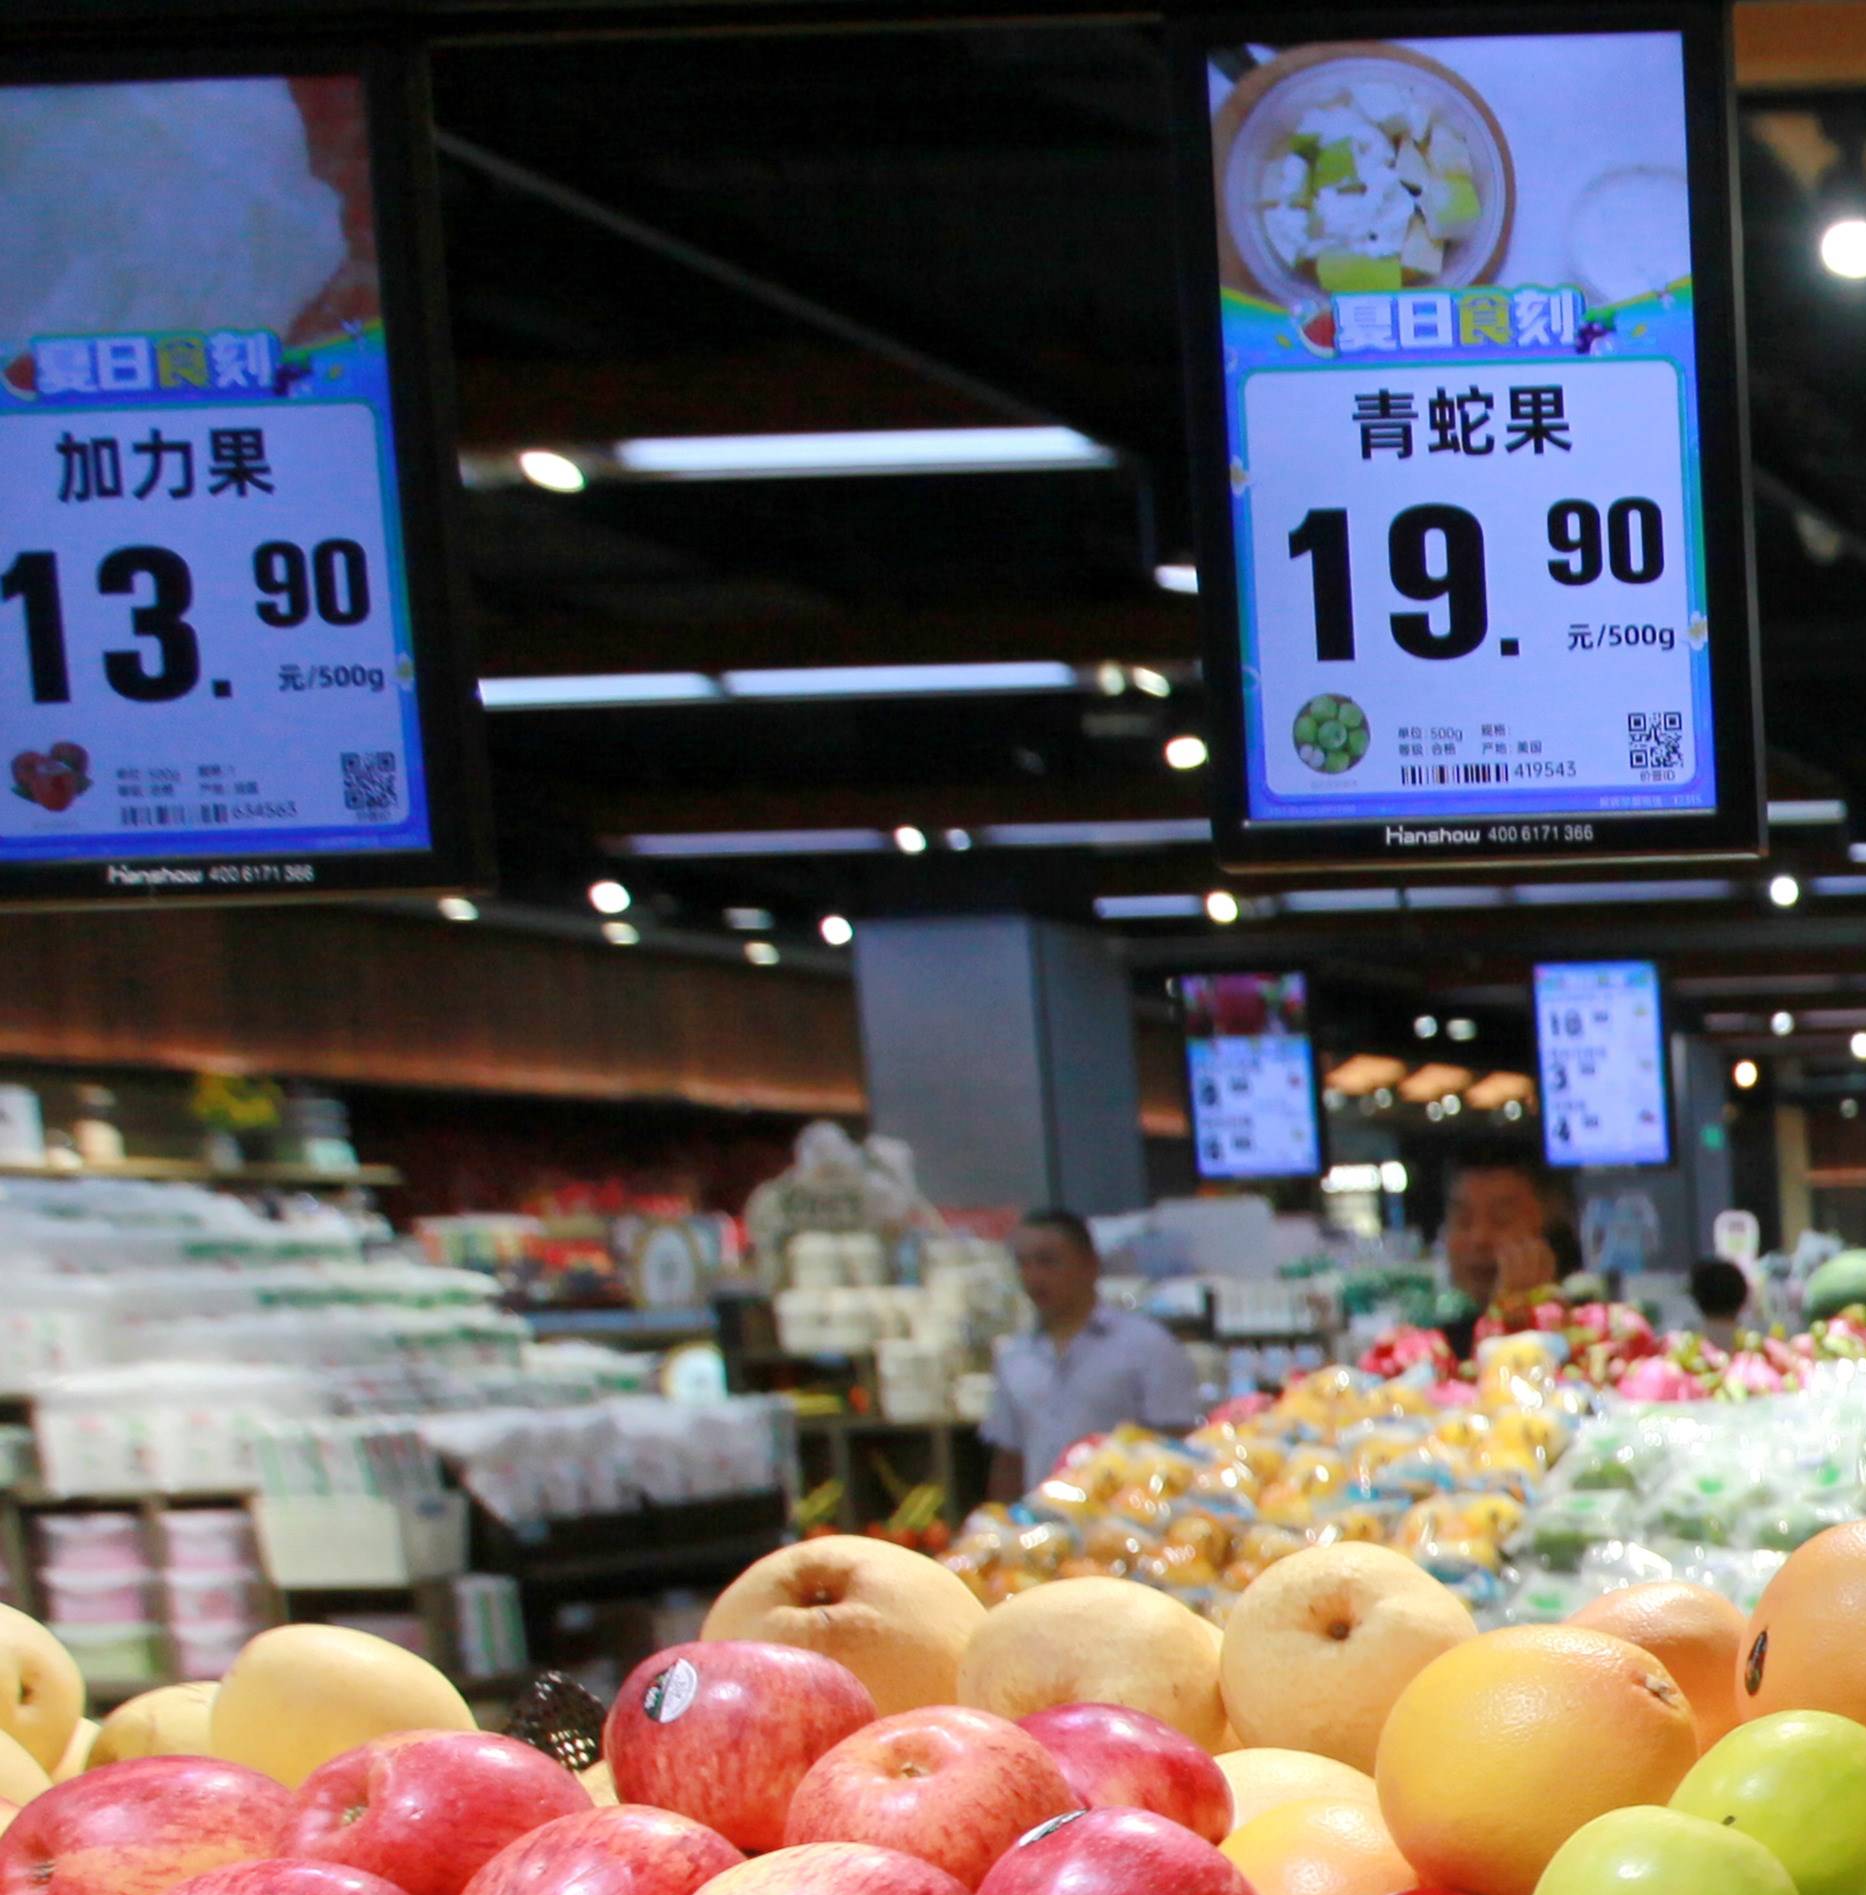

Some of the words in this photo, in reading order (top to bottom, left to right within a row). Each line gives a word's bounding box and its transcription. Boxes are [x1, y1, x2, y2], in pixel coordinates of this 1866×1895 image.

[1337, 290, 1579, 351] 夏日食刻
[1352, 385, 1573, 459] 青蛇果
[56, 428, 275, 502] 加力果
[1547, 496, 1665, 586] 90
[252, 538, 371, 627] 90
[1567, 624, 1675, 651] 元/500g
[278, 664, 384, 693] 元/500g
[1514, 762, 1576, 779] 419543
[1386, 826, 1480, 845] Hanshow
[1489, 827, 1517, 843] 400
[1521, 826, 1560, 842] 6171
[1563, 825, 1593, 841] 366
